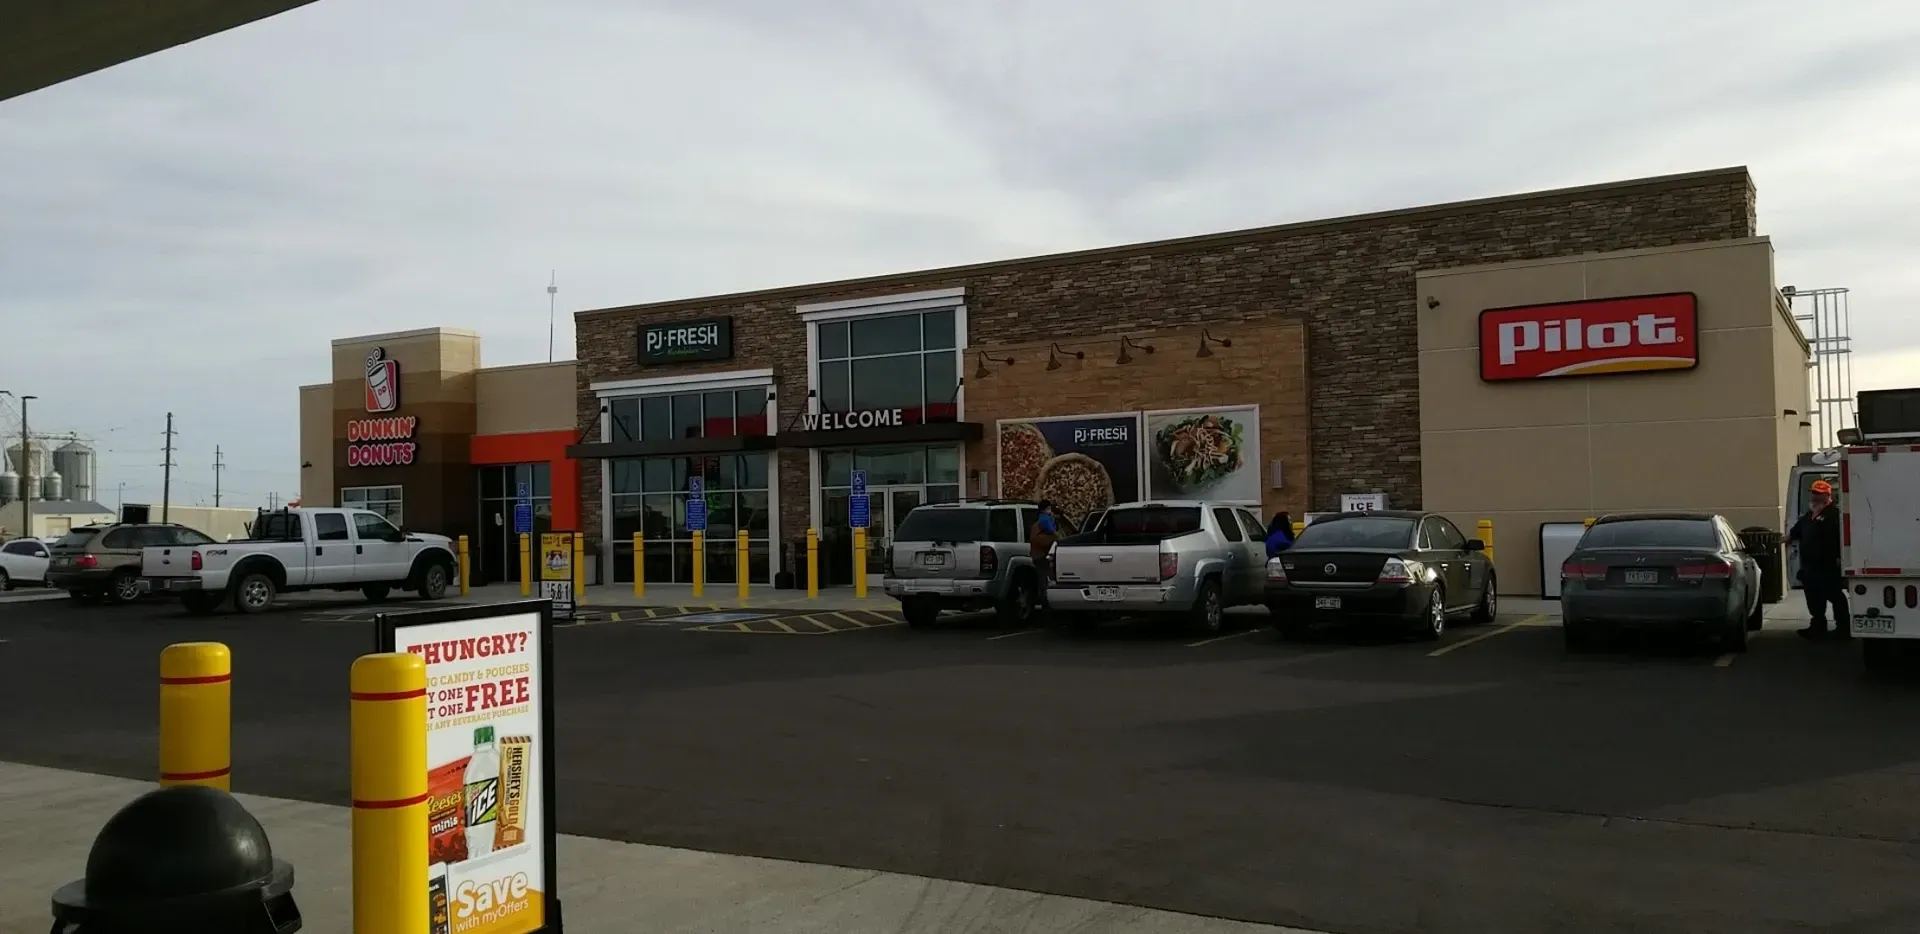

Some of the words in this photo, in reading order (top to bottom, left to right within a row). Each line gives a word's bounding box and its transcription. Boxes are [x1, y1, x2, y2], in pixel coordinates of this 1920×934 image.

[347, 415, 416, 442] DUNKIN'
[801, 408, 903, 431] WELCOME
[1350, 502, 1374, 511] ICE
[440, 671, 475, 685] CANDY
[485, 663, 530, 678] POUCHES
[438, 687, 463, 702] ONE
[465, 677, 530, 713] FREE
[438, 703, 464, 717] ONE
[431, 816, 459, 834] minis
[456, 871, 528, 918] Save
[455, 914, 480, 933] with
[482, 899, 529, 924] myOffers
